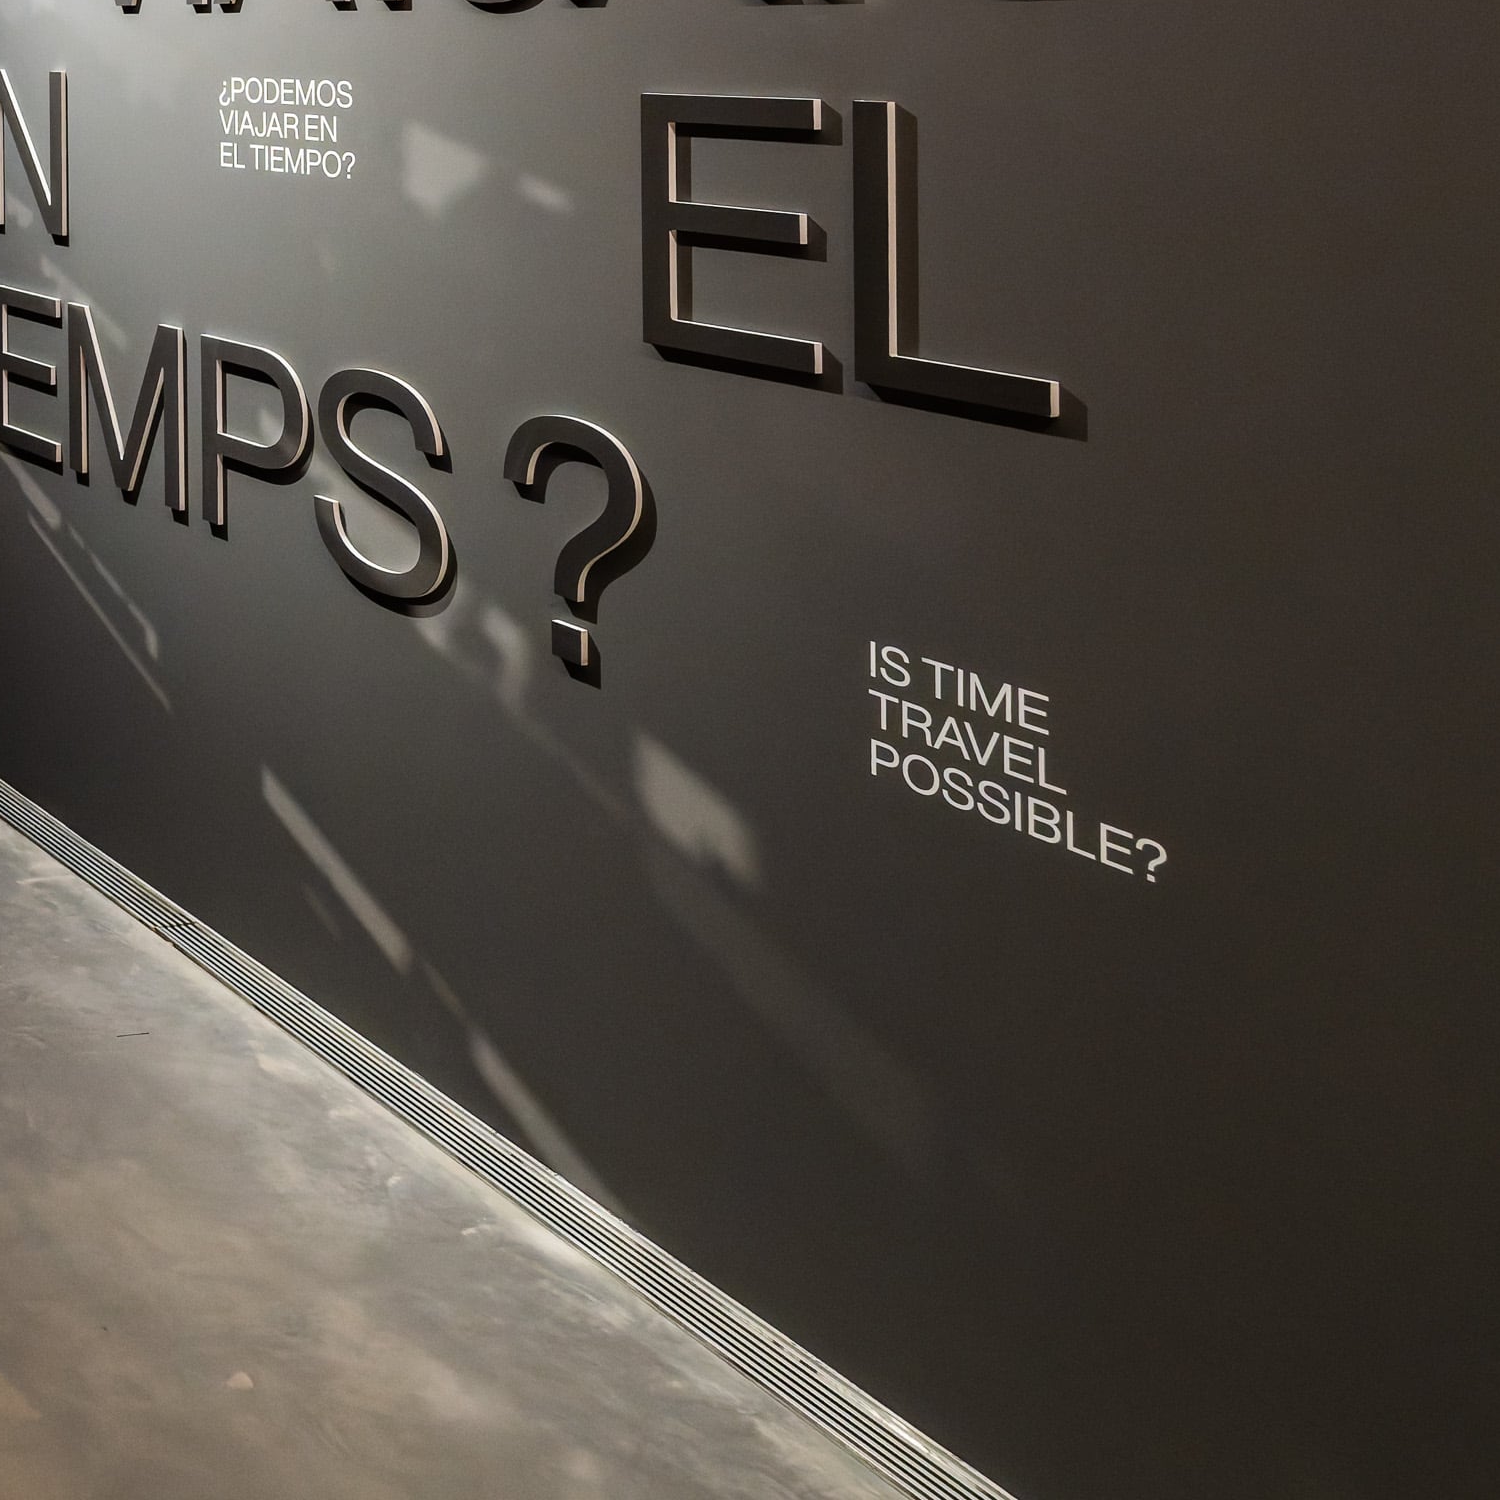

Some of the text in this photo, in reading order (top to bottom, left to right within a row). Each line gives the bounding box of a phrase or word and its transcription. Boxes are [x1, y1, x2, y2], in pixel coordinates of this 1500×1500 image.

[218, 76, 353, 109] ¿PODEMOS
[218, 108, 338, 143] VIAJAR EN
[219, 141, 356, 180] EL TIEMPO?
[641, 92, 1063, 430] EL
[868, 639, 1050, 736] IS TIME
[868, 687, 1068, 796] TRAVEL
[869, 737, 1168, 884] POSSIBLE?
